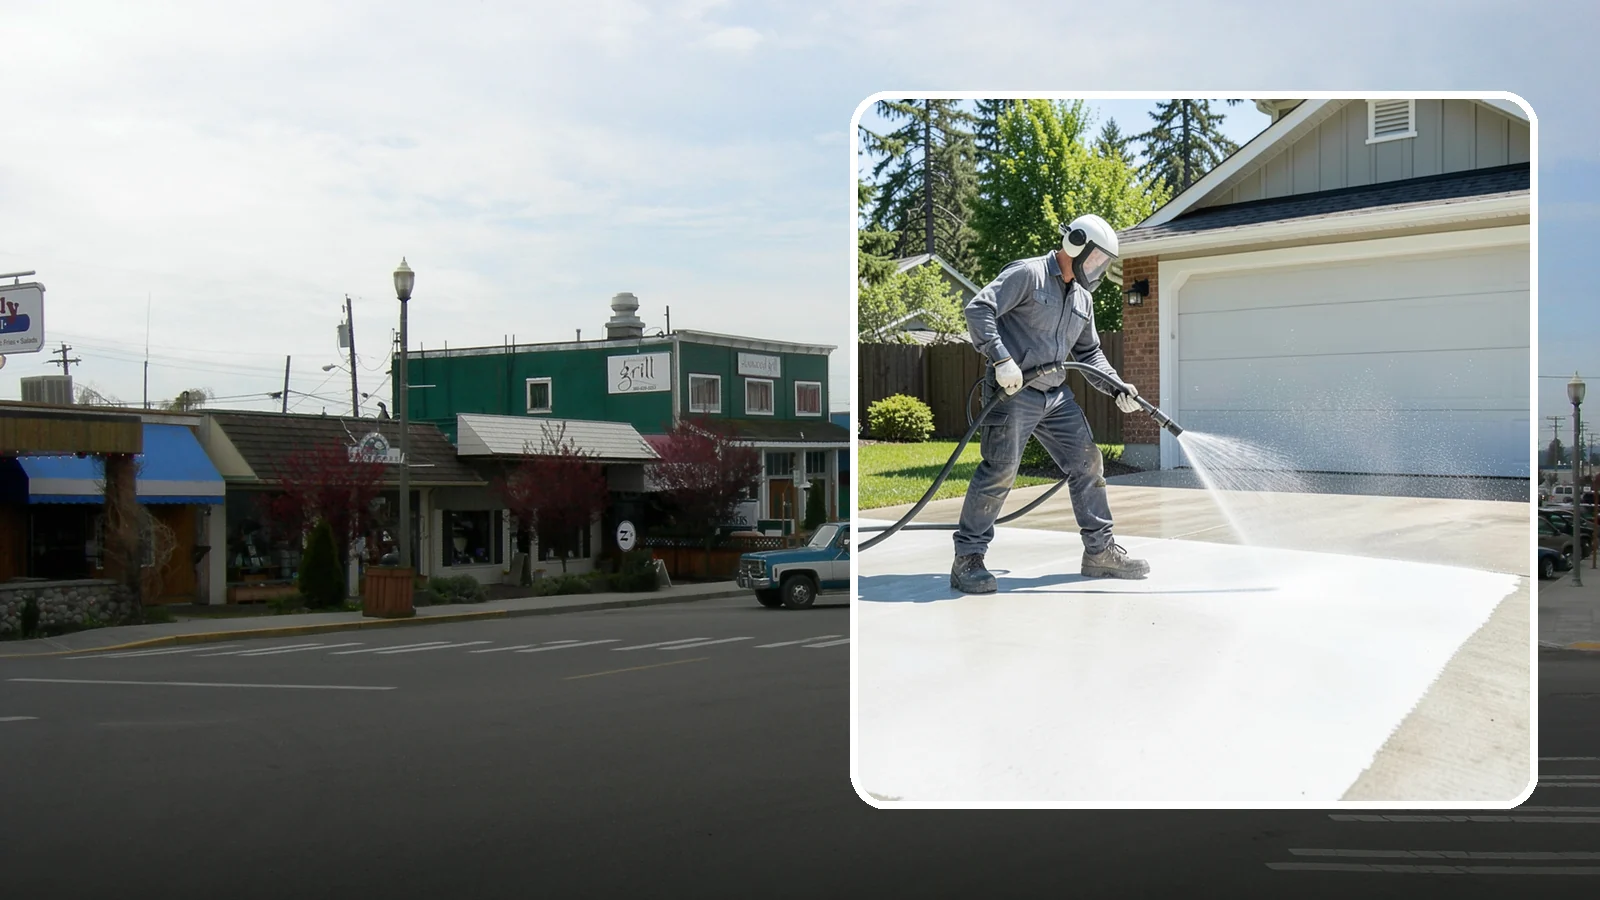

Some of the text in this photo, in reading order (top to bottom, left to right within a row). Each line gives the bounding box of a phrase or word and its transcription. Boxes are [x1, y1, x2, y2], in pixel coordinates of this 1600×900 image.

[3, 338, 16, 346] Fries
[20, 336, 38, 345] Salads
[617, 356, 654, 391] grill
